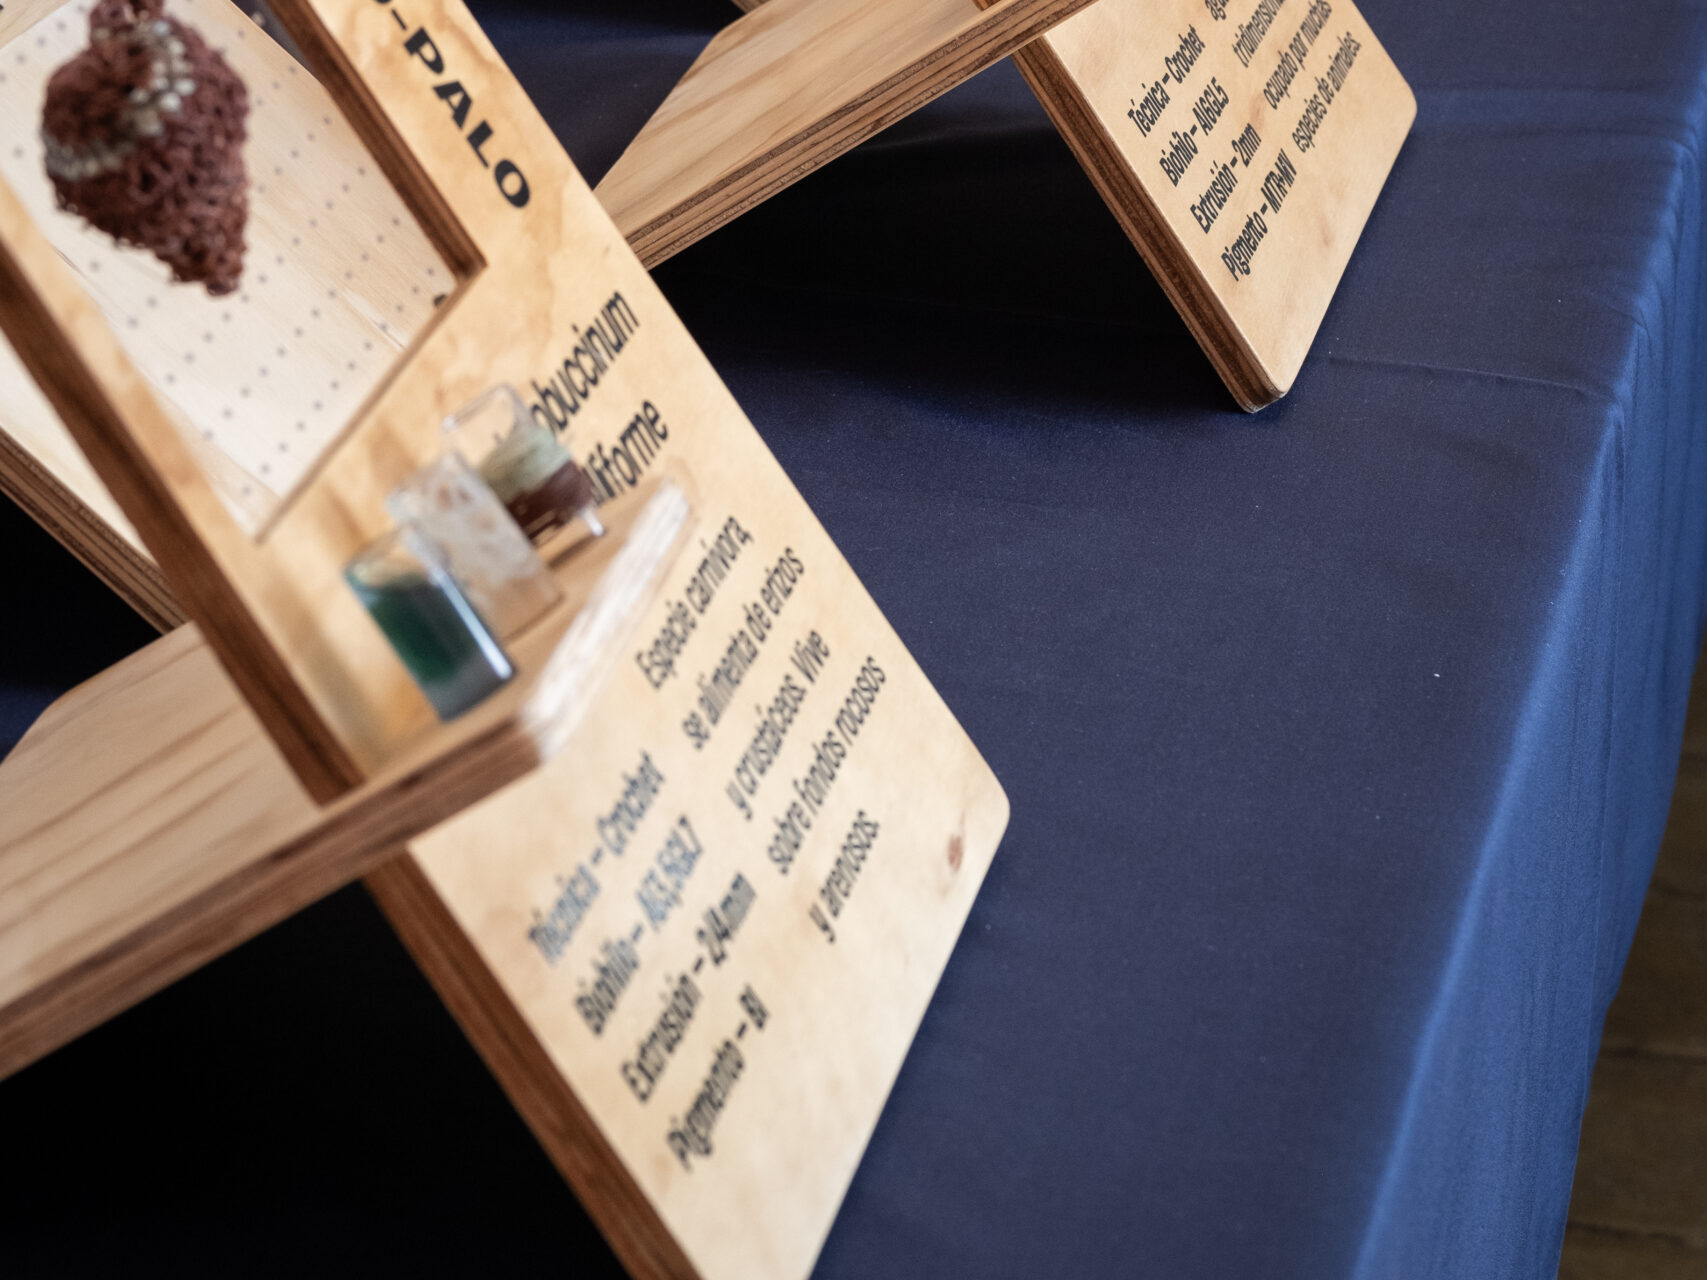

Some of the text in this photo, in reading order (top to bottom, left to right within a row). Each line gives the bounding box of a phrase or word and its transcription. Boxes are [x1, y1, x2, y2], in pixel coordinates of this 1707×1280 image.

[1127, 83, 1171, 138] Técnica
[1164, 24, 1206, 84] Crochet
[1263, 50, 1298, 110] ocupado
[1289, 31, 1309, 70] por
[1292, 94, 1327, 153] especies
[1315, 76, 1334, 105] de
[1159, 131, 1199, 187] Biohilo
[1190, 160, 1238, 234] Extrusión
[1231, 123, 1262, 168] 2mm
[1221, 210, 1268, 282] Pigmento
[635, 601, 697, 691] Especie
[682, 546, 804, 750] se alimenta de erizos
[725, 779, 752, 821] y
[790, 630, 830, 684] Vive
[768, 656, 886, 876] sobre fondos rocosos
[596, 750, 665, 857] Crochet
[809, 902, 836, 944] y
[620, 974, 702, 1104] Extrusión
[666, 1039, 745, 1173] Pigmento
